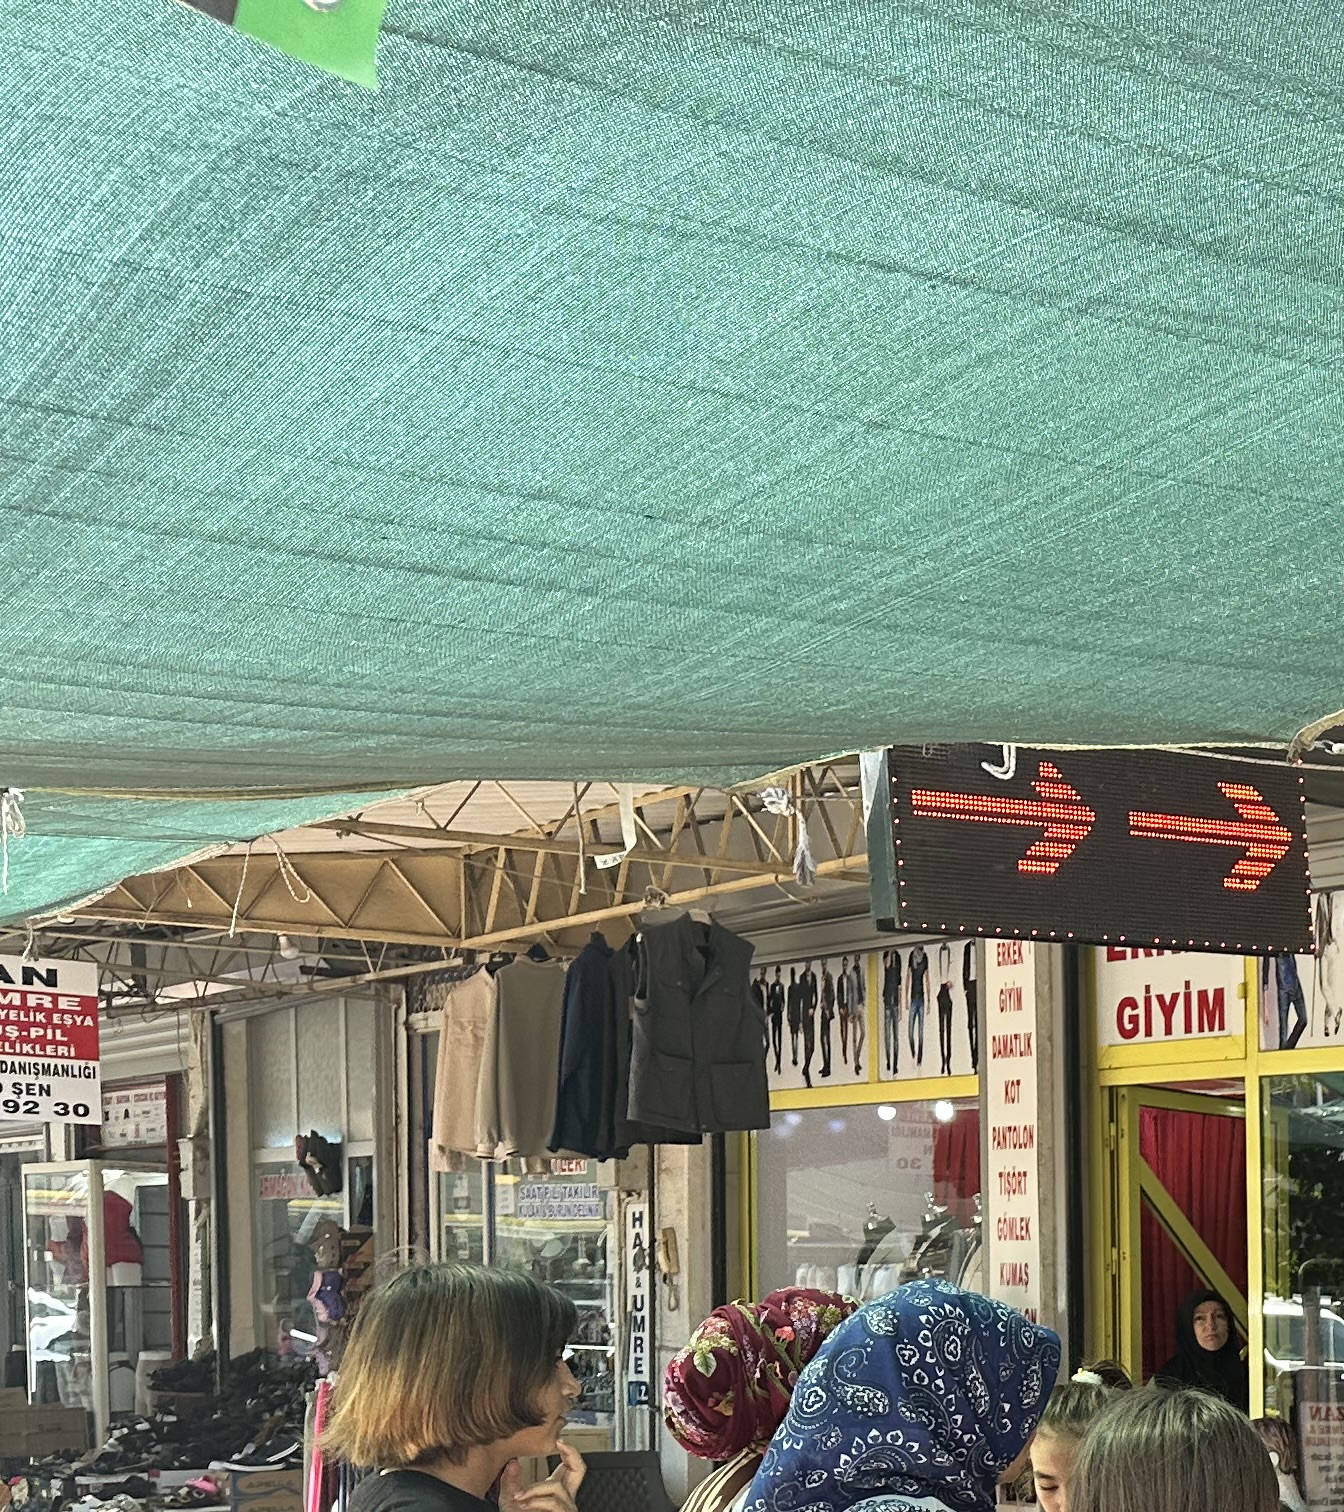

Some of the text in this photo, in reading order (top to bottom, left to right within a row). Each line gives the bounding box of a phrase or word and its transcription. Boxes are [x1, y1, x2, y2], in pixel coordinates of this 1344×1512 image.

[996, 940, 1024, 968] ERKEK
[999, 980, 1023, 1013] GİYİM
[1116, 980, 1226, 1040] GİYİM
[0, 1025, 68, 1042] Ş-PİL
[52, 1013, 94, 1028] EŞYA
[992, 1031, 1033, 1060] DAMATLIK
[12, 1082, 52, 1099] ŞEN
[1004, 1079, 1022, 1105] KOT
[53, 1102, 90, 1118] 30
[992, 1124, 1035, 1150] PANTOLON
[998, 1165, 1028, 1203] TİŞÖRT
[997, 1212, 1031, 1242] GÖMLEK
[1000, 1262, 1030, 1293] KUMAŞ
[631, 1294, 646, 1375] UMRE
